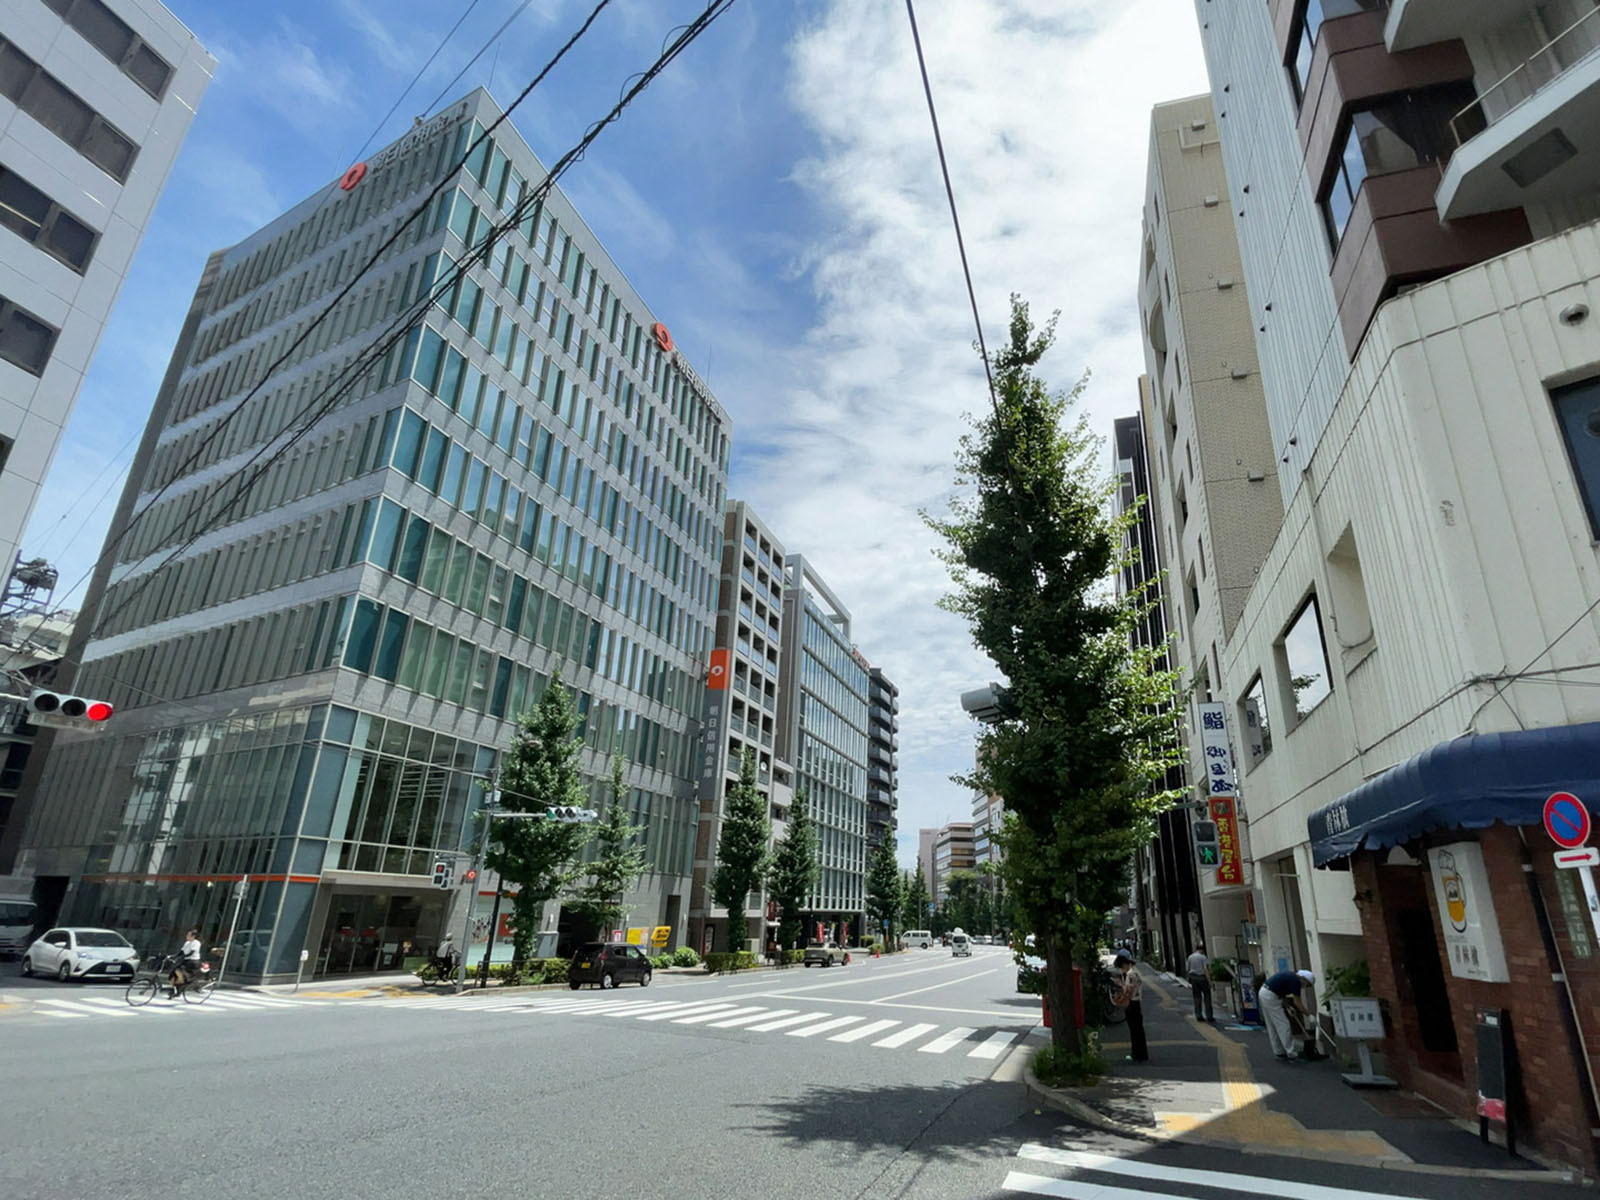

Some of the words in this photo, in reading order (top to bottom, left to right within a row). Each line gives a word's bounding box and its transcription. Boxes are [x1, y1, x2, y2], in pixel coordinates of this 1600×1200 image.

[703, 705, 719, 778] 朝日信用金庫
